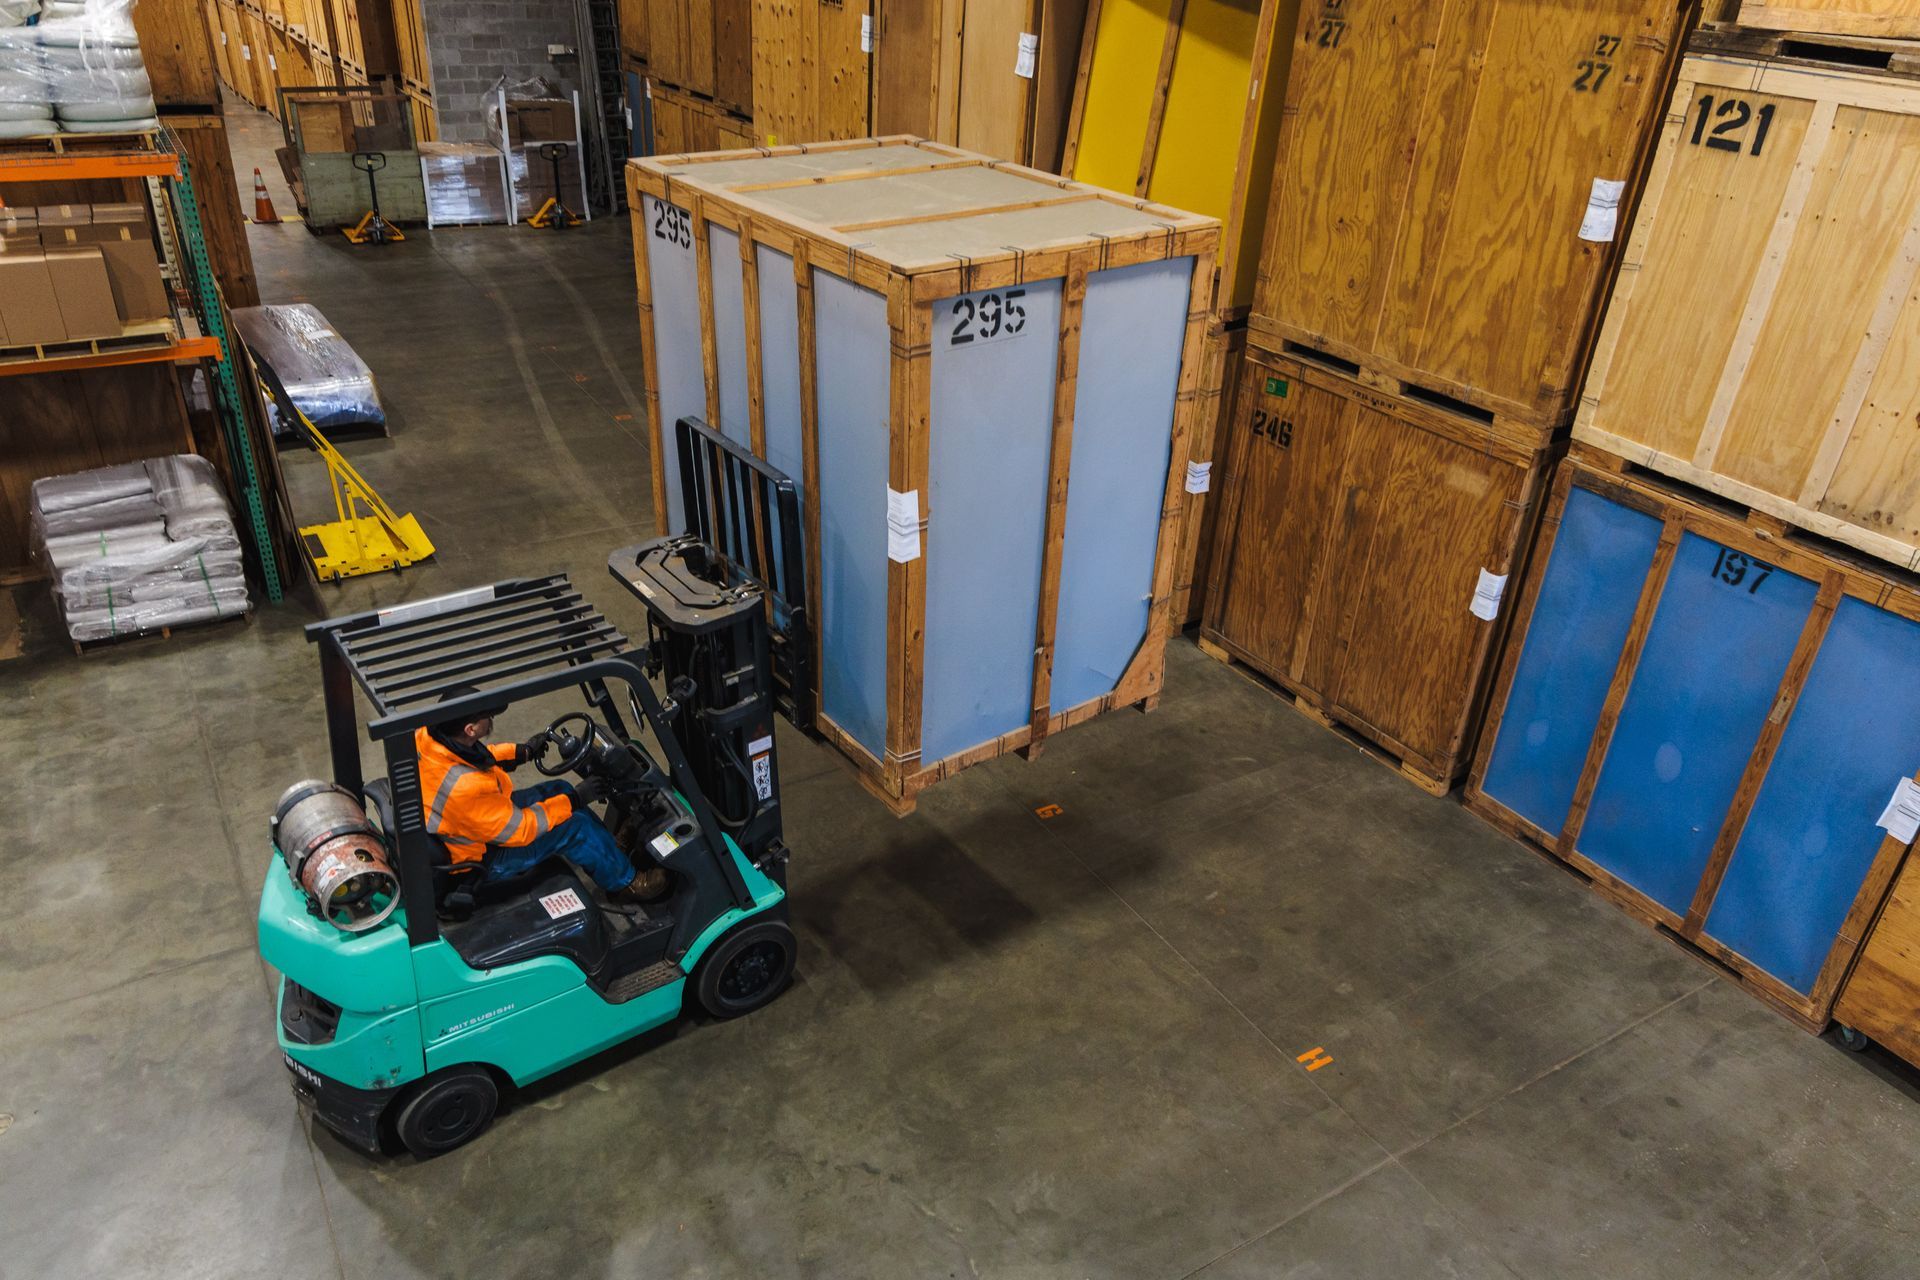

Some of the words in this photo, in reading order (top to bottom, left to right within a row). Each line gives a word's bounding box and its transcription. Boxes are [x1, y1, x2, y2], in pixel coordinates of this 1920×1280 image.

[1317, 20, 1345, 49] 27
[1595, 35, 1622, 57] 27
[1573, 60, 1613, 94] 27
[1690, 95, 1776, 156] 121
[654, 200, 691, 250] 295
[951, 289, 1026, 346] 295
[1252, 409, 1293, 449] 246
[1711, 547, 1774, 595] 197
[448, 1003, 515, 1033] MITSUBISHI
